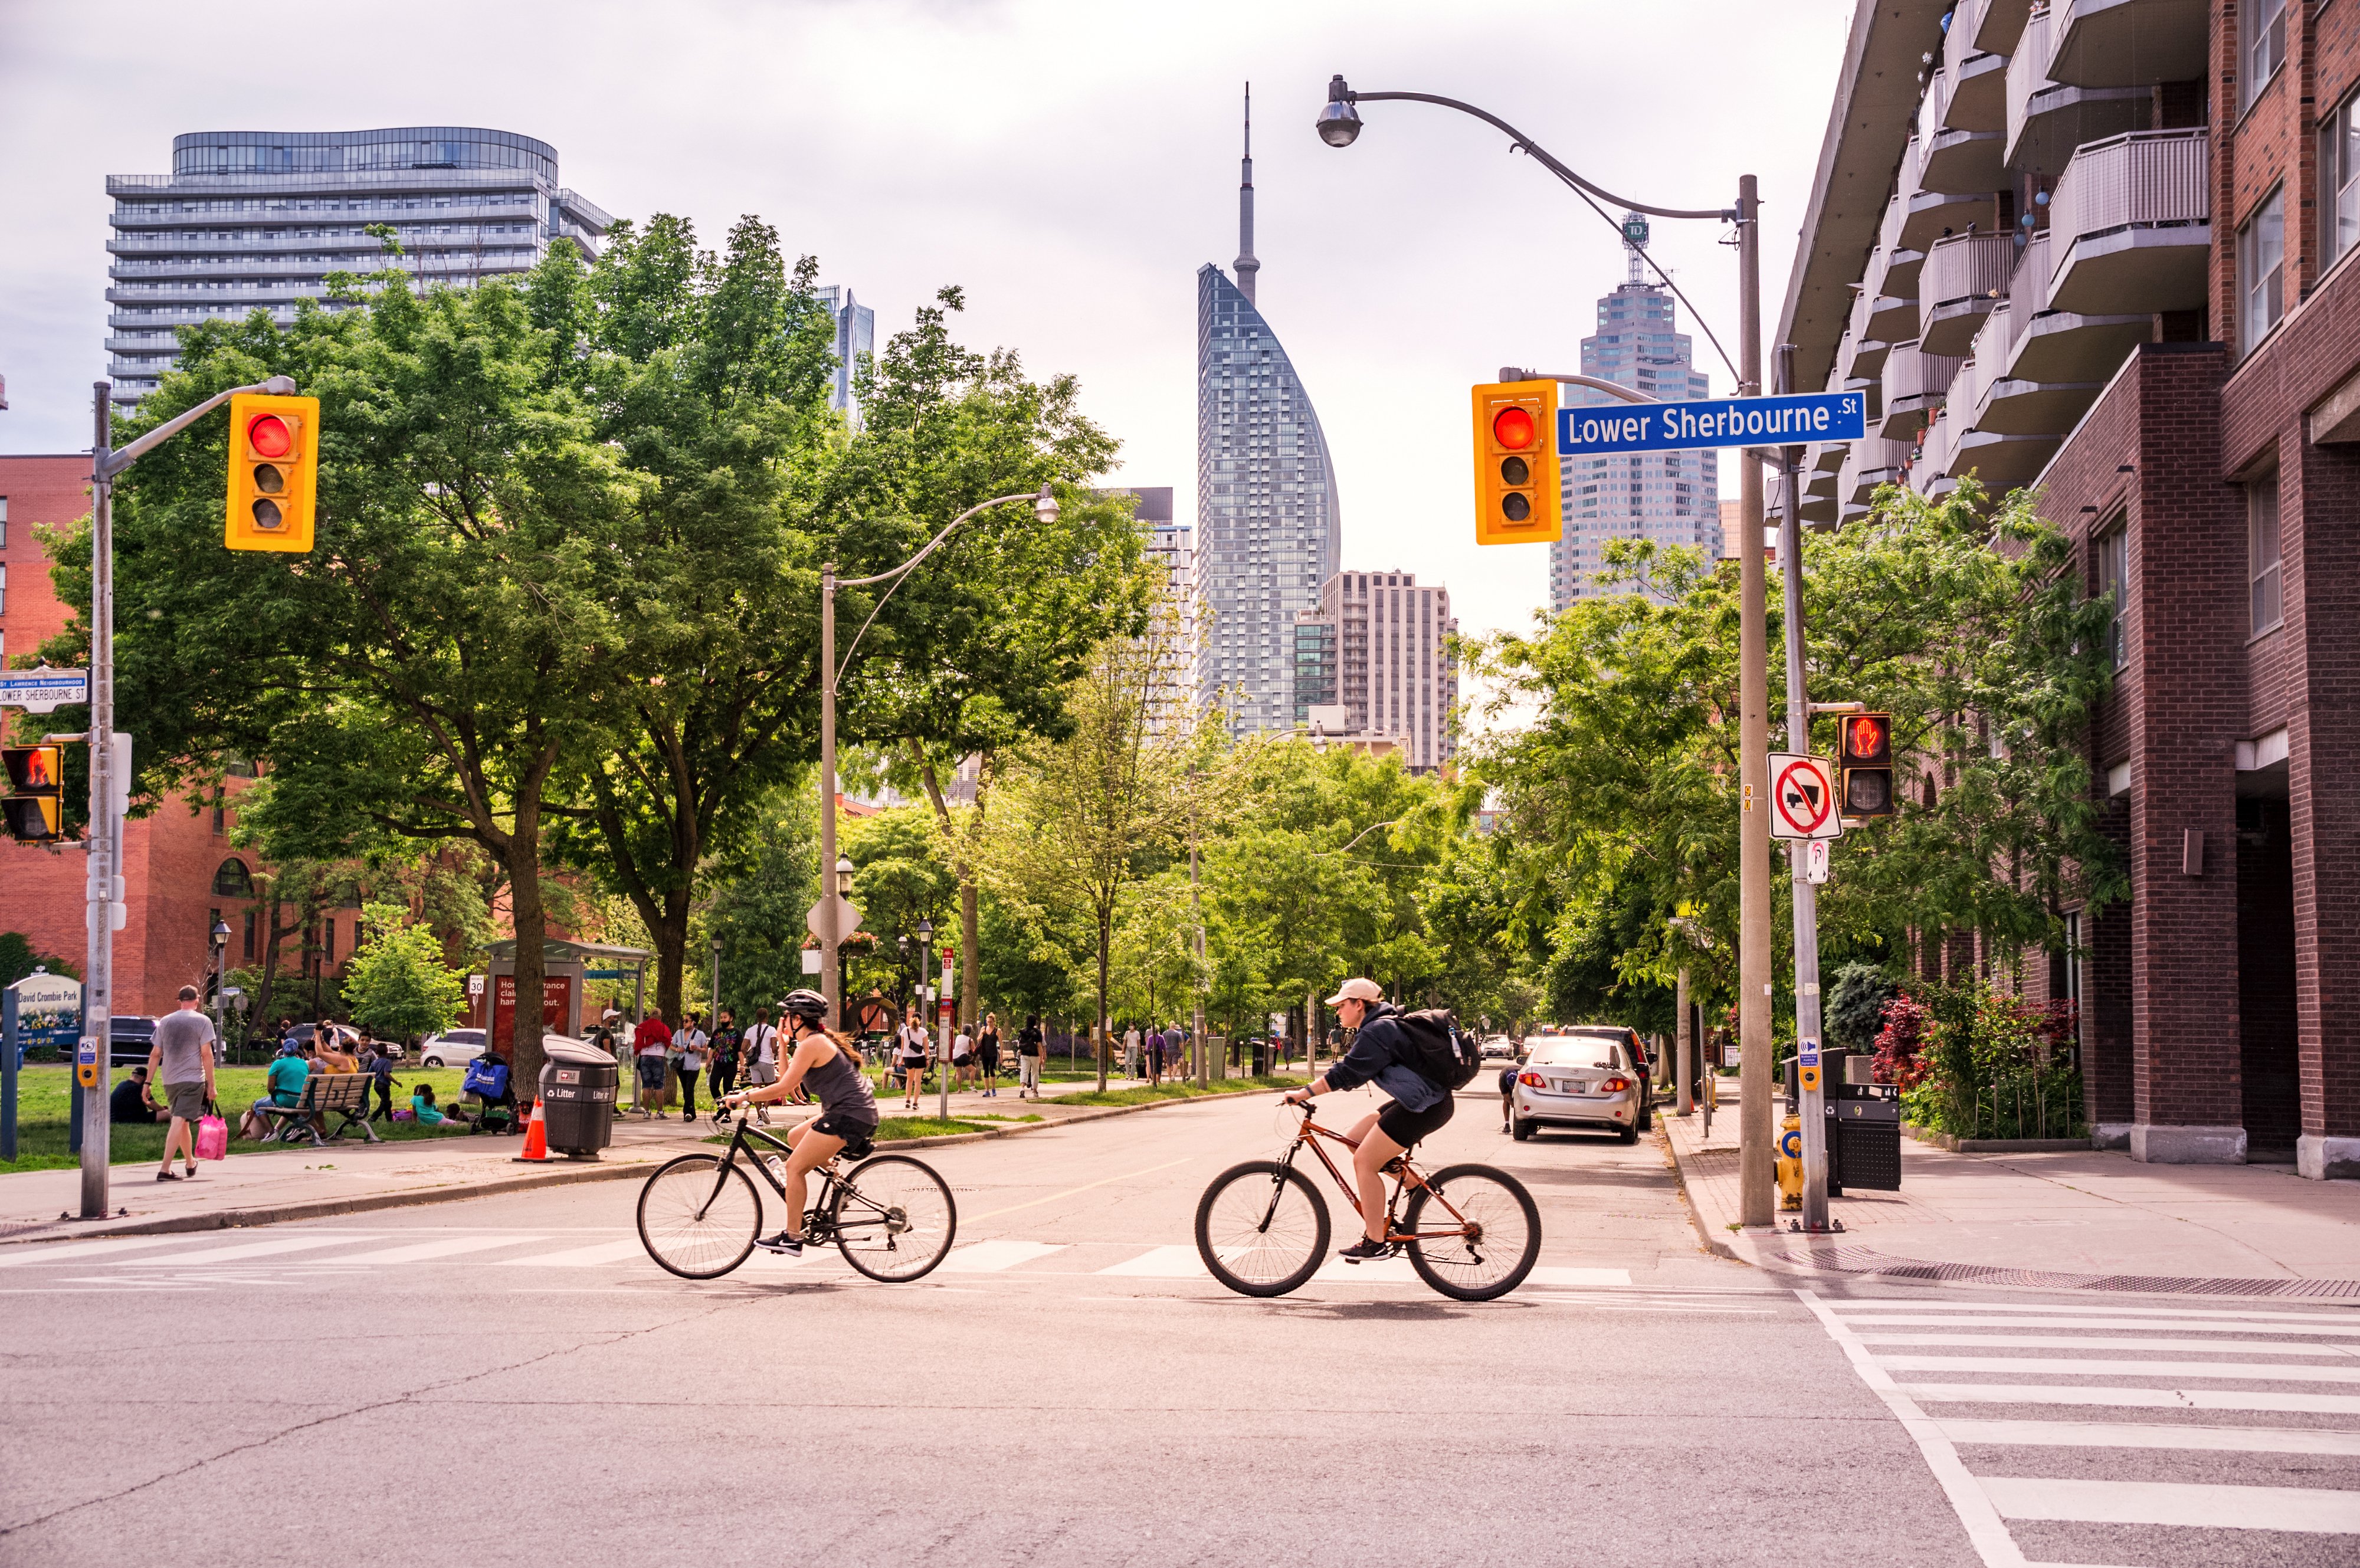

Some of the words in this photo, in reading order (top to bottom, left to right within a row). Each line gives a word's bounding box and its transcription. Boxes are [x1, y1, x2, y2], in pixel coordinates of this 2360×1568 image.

[1628, 225, 1643, 235] TD
[1569, 413, 1650, 444] Lower
[1663, 405, 1830, 439] Sherbourne
[1841, 397, 1857, 415] St
[26, 689, 72, 701] SHERBOURNE
[76, 688, 84, 699] ST
[471, 983, 482, 991] 30
[19, 992, 35, 1003] David
[37, 991, 62, 1002] Crombie
[64, 990, 77, 1000] Park
[557, 1088, 576, 1098] Litter
[593, 1090, 604, 1100] Litter
